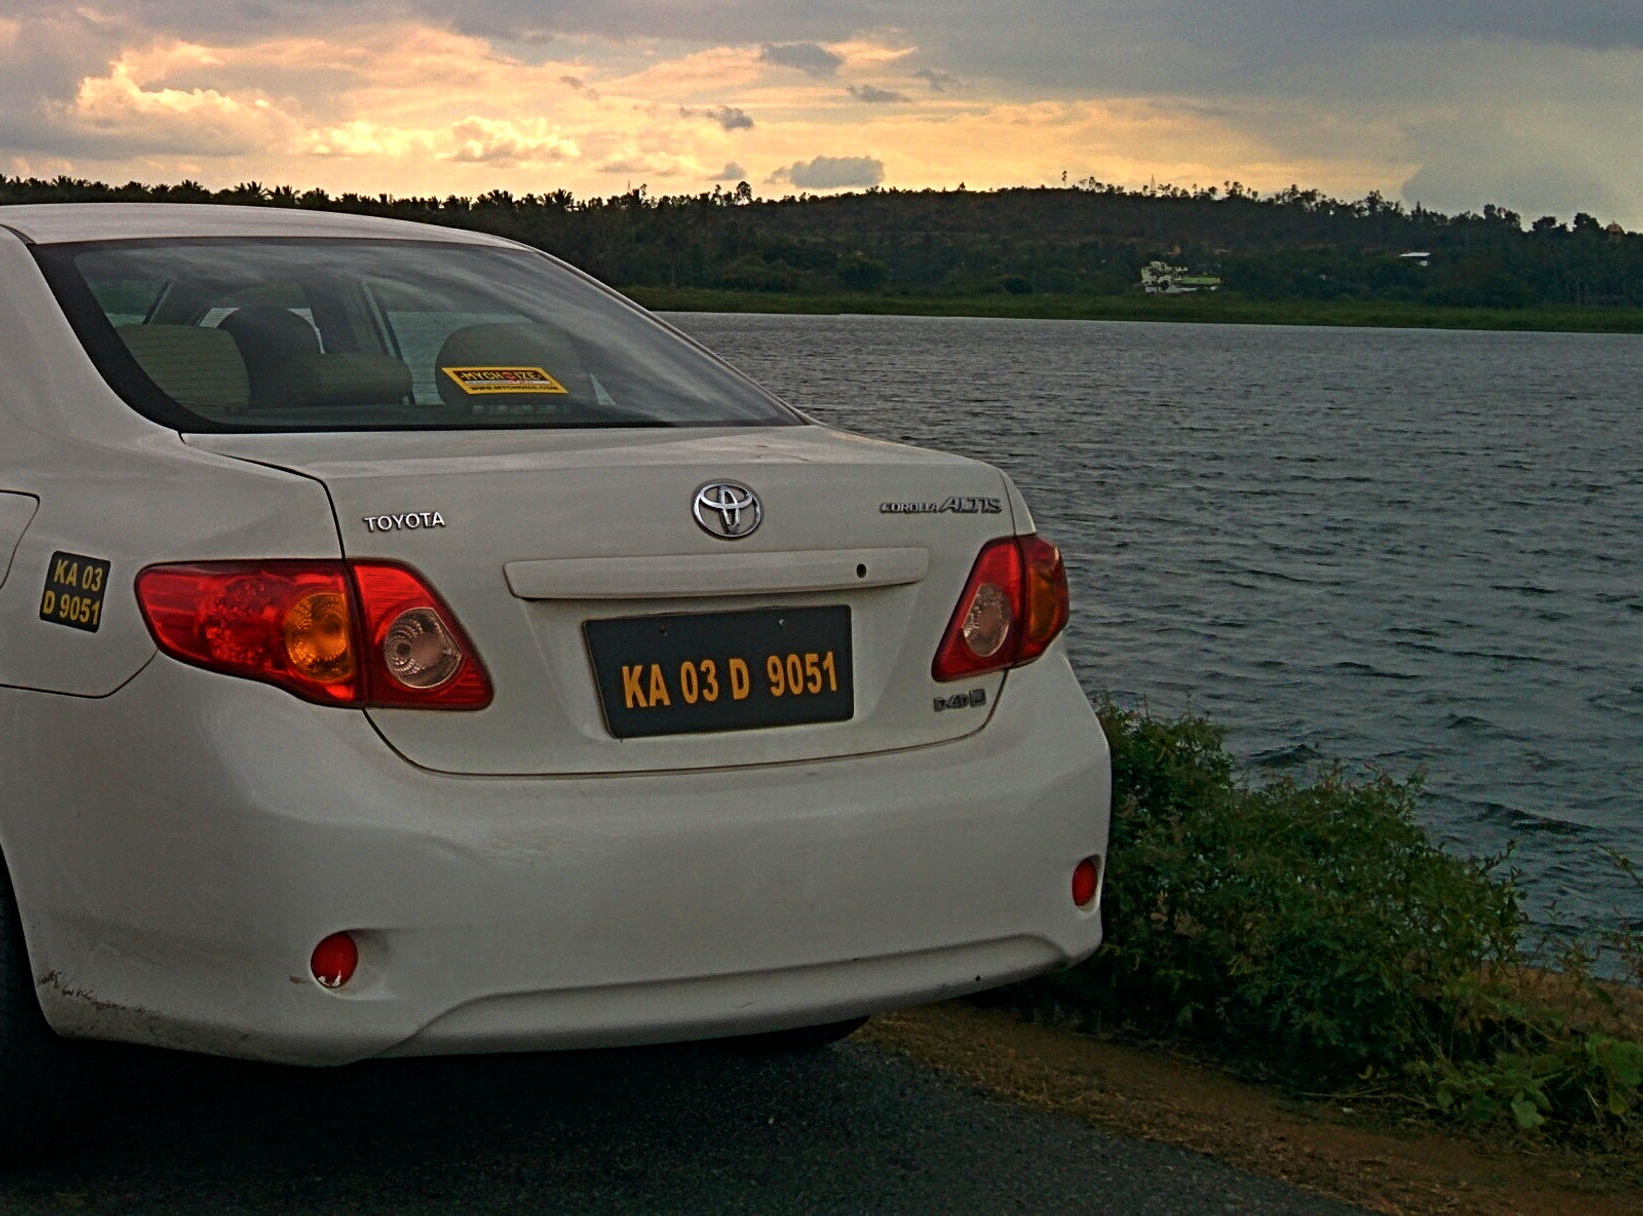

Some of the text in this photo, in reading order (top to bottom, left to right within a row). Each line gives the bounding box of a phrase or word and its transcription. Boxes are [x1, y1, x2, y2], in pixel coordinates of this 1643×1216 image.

[363, 511, 446, 532] TOYOTA
[880, 496, 1003, 514] COROLLA ALTIS
[54, 559, 103, 592] KA 03
[43, 590, 100, 625] D 9051
[622, 651, 837, 709] KA 03 D 9051
